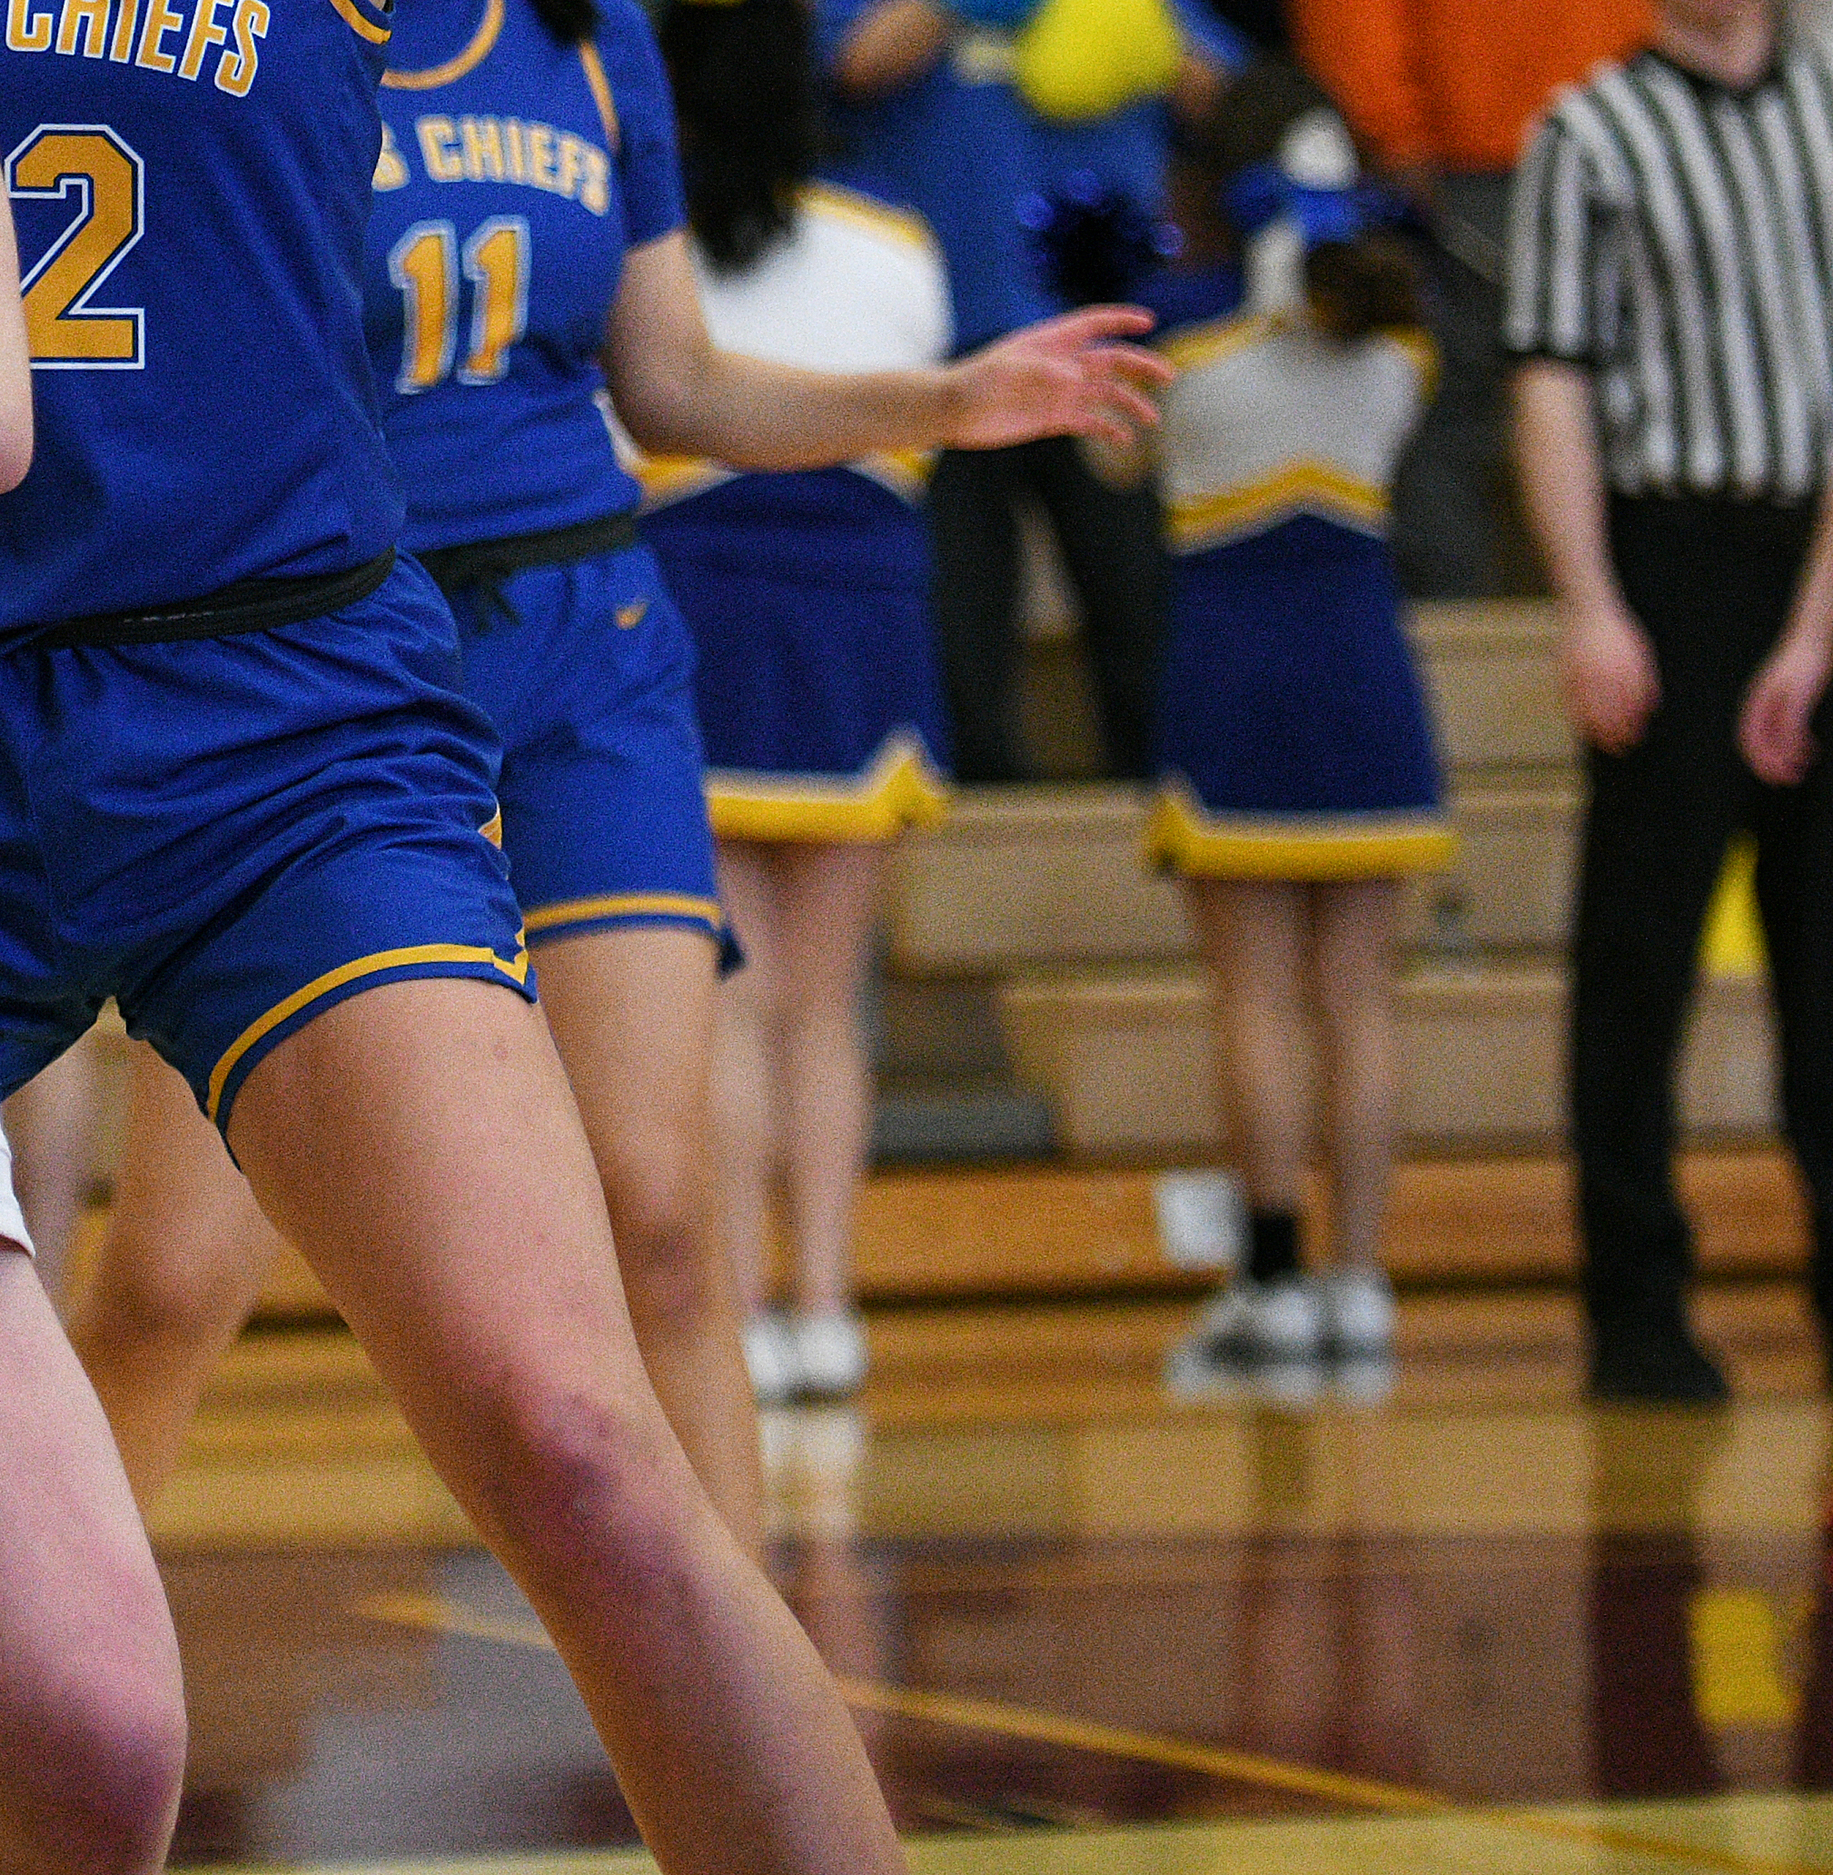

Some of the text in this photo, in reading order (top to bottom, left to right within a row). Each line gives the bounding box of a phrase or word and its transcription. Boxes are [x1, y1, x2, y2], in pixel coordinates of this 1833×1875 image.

[6, 123, 146, 370] 2
[416, 114, 612, 217] CHIEFS
[387, 214, 533, 395] 11
